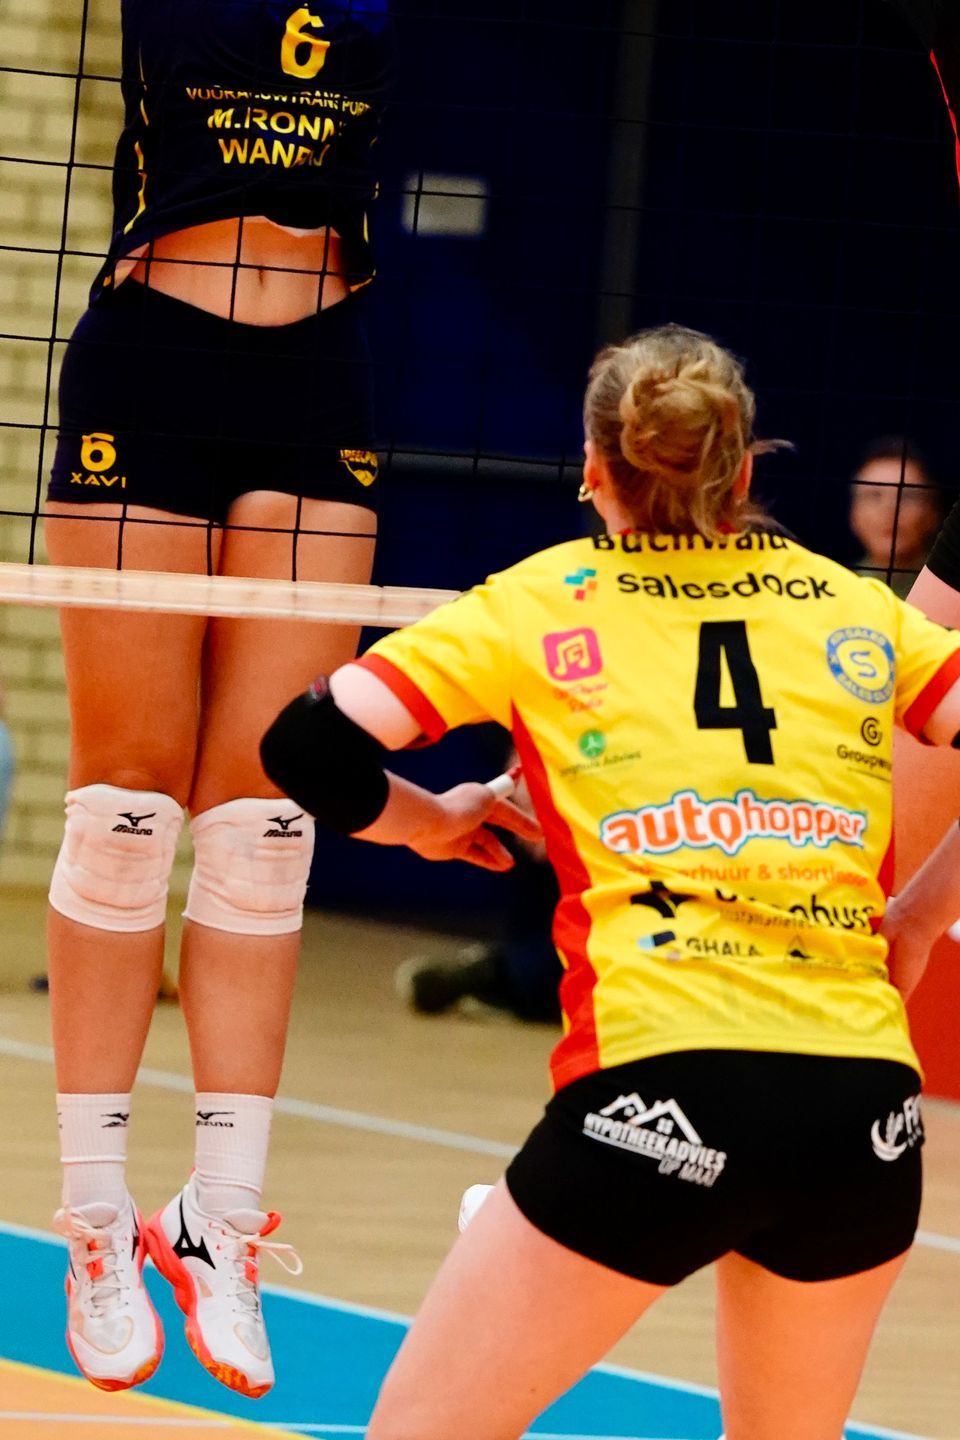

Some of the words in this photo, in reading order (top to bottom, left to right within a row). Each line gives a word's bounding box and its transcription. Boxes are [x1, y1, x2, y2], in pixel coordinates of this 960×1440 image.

[281, 7, 331, 80] 6
[80, 432, 117, 473] 6
[70, 471, 127, 489] XAVI
[617, 572, 836, 600] salesdock
[693, 619, 778, 766] 4
[602, 791, 866, 854] autohopper
